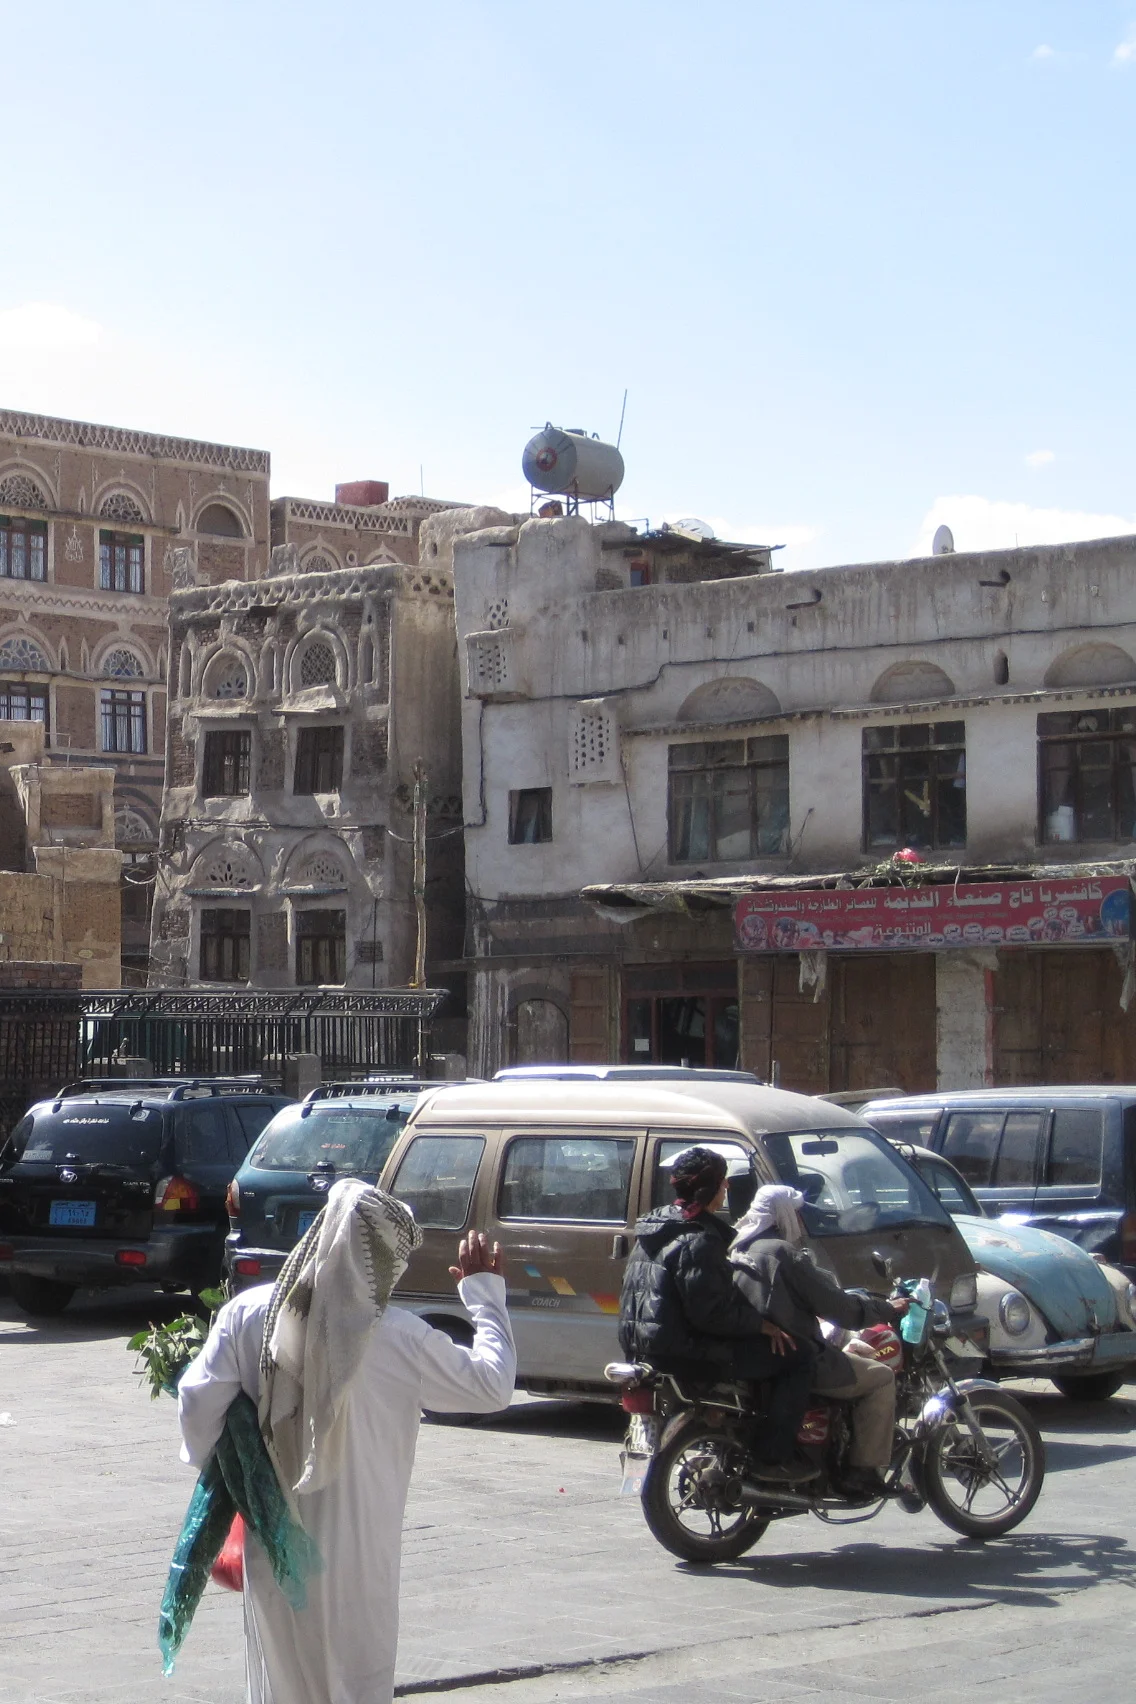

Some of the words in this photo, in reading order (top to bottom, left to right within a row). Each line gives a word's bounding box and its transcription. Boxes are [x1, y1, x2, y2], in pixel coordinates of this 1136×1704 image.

[884, 889, 940, 914] القديمة
[1009, 887, 1035, 908] تاج
[1039, 881, 1103, 907] كافتيريا
[531, 1297, 561, 1308] COACH
[874, 1346, 895, 1358] NYA
